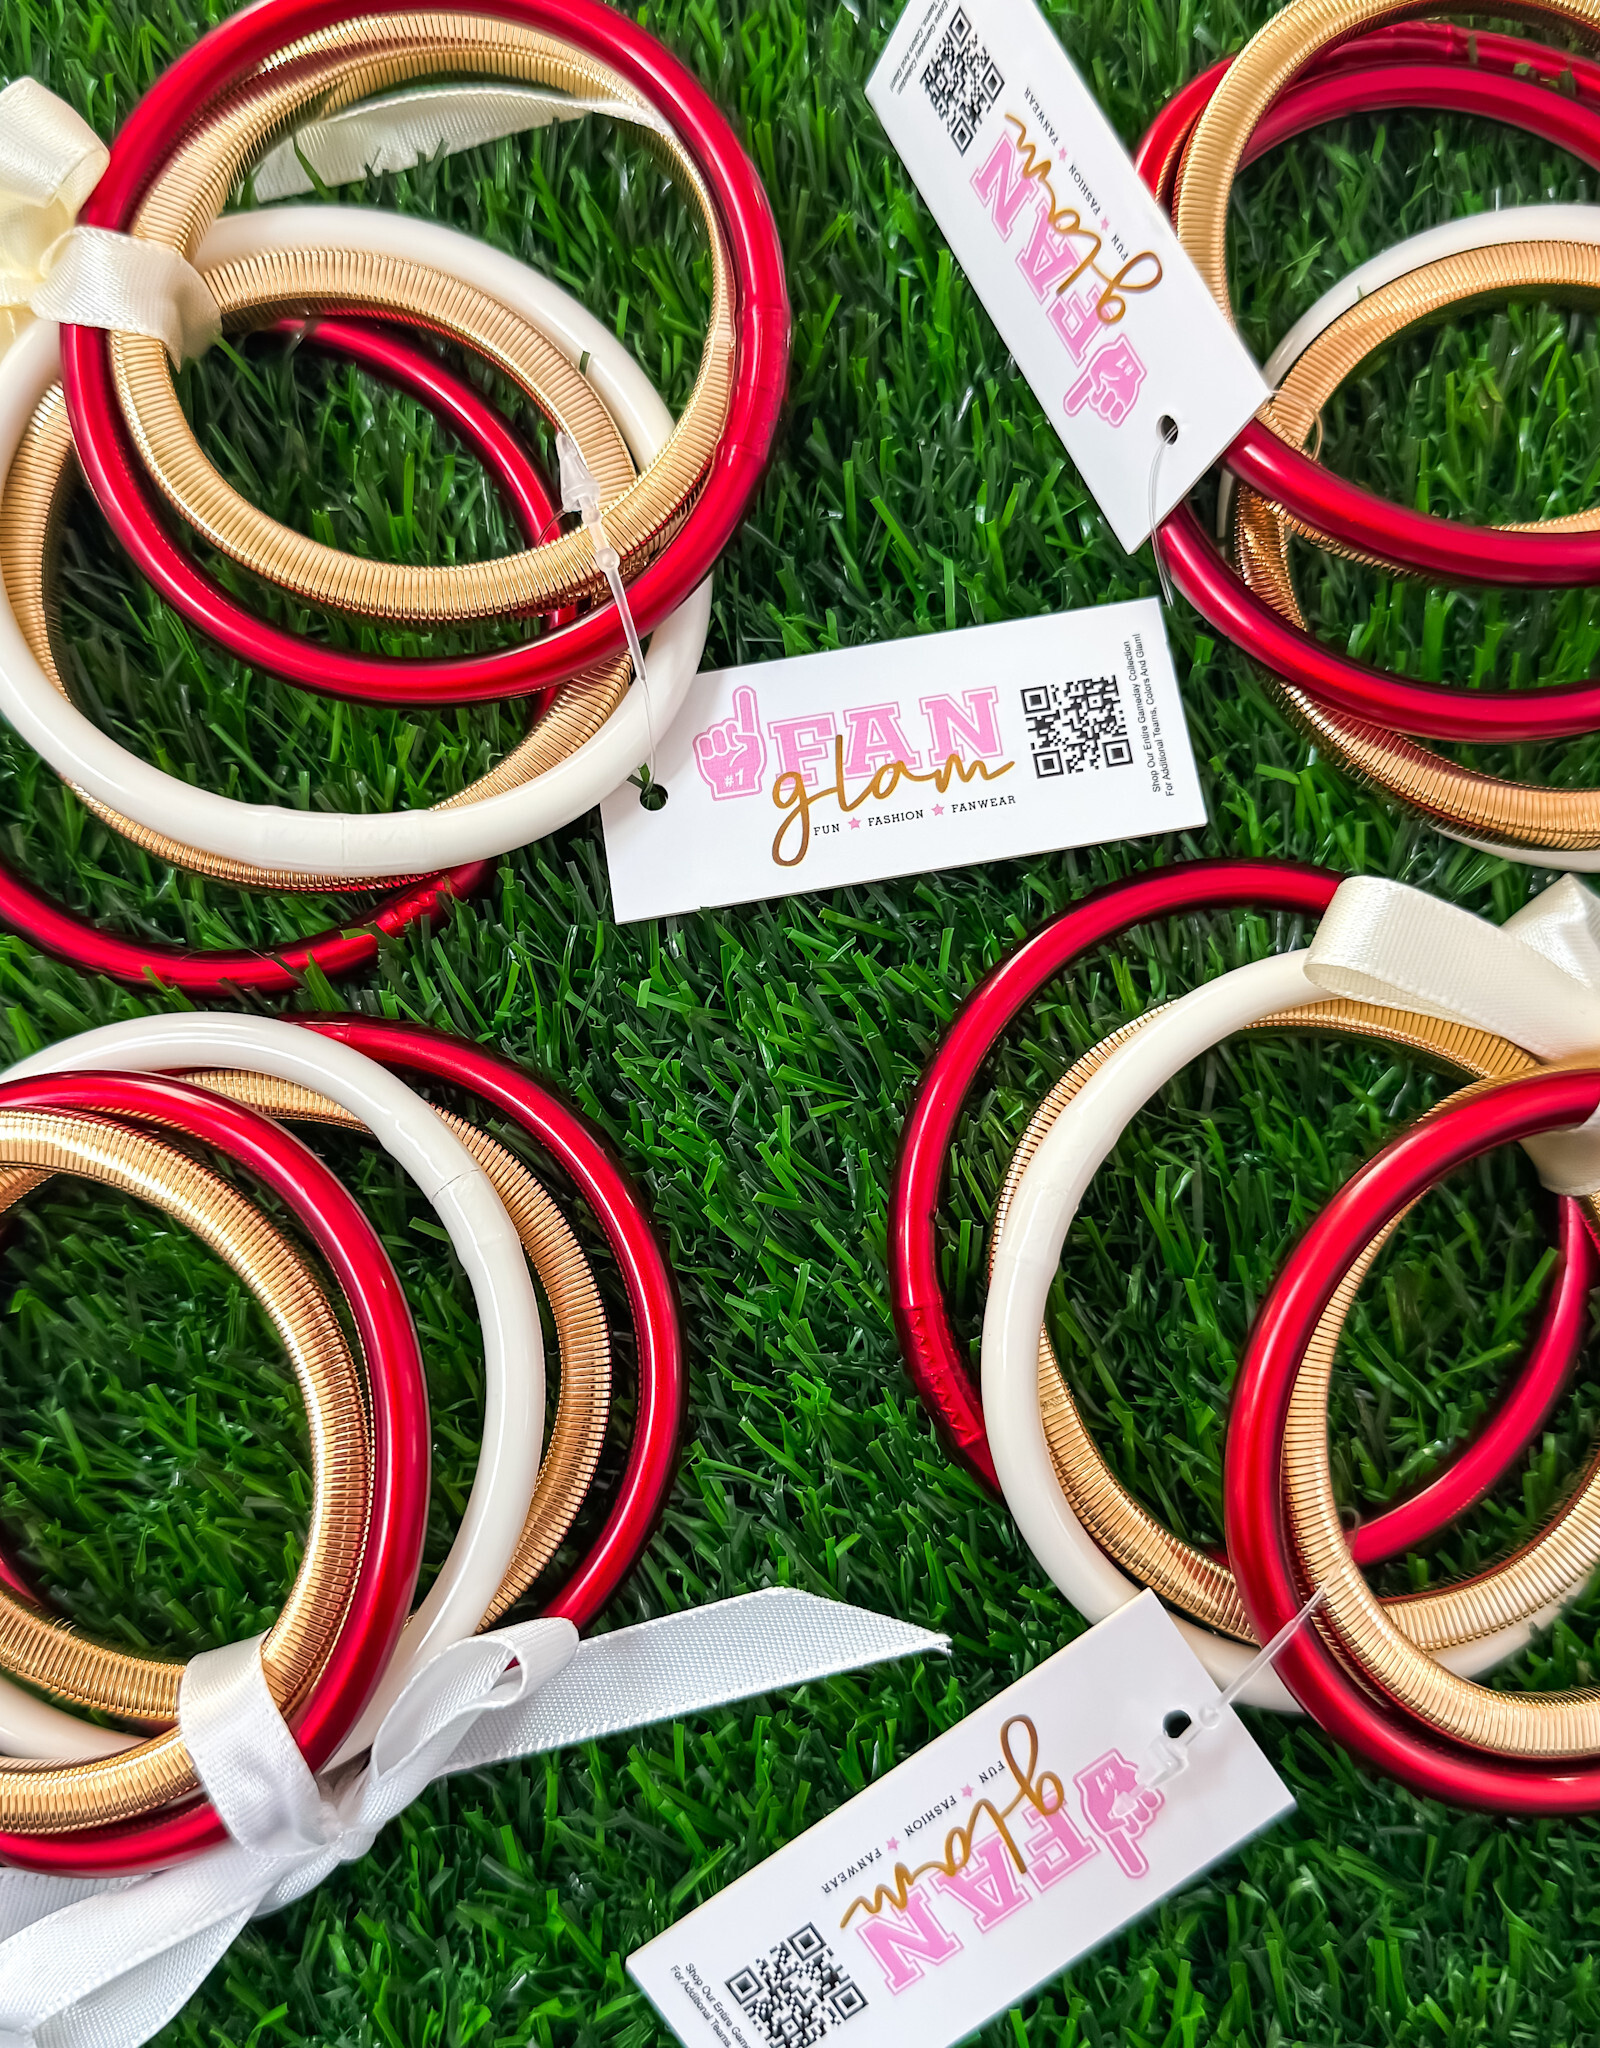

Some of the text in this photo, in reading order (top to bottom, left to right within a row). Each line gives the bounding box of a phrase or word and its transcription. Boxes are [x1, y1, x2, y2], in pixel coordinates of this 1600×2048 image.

[900, 51, 910, 71] And
[908, 28, 923, 53] Colors
[915, 24, 936, 61] Gameday
[1024, 86, 1128, 262] FUN FASHION FANWEAR
[1005, 113, 1163, 324] glam
[970, 130, 1116, 368] FAN
[1132, 633, 1145, 658] Glam!
[1138, 659, 1149, 677] And
[1123, 641, 1161, 792] Shop Our Entire Gameday Collection
[1143, 678, 1154, 705] Colors
[767, 686, 1003, 791] FAN
[1154, 739, 1171, 780] Additional
[724, 767, 744, 788] #1
[772, 735, 1015, 867] glam
[1165, 782, 1175, 796] For
[813, 795, 1016, 836] FUN FASHION FANWEAR
[821, 1760, 1006, 1894] FUN FASHION FANWEAR
[840, 1714, 1065, 1928] glam
[855, 1788, 1101, 1996] FAN
[670, 1964, 685, 1981] For
[681, 1980, 714, 2020] Additional
[685, 1962, 703, 1986] Shop
[702, 1985, 716, 2002] Our
[713, 2001, 732, 2027] Entire
